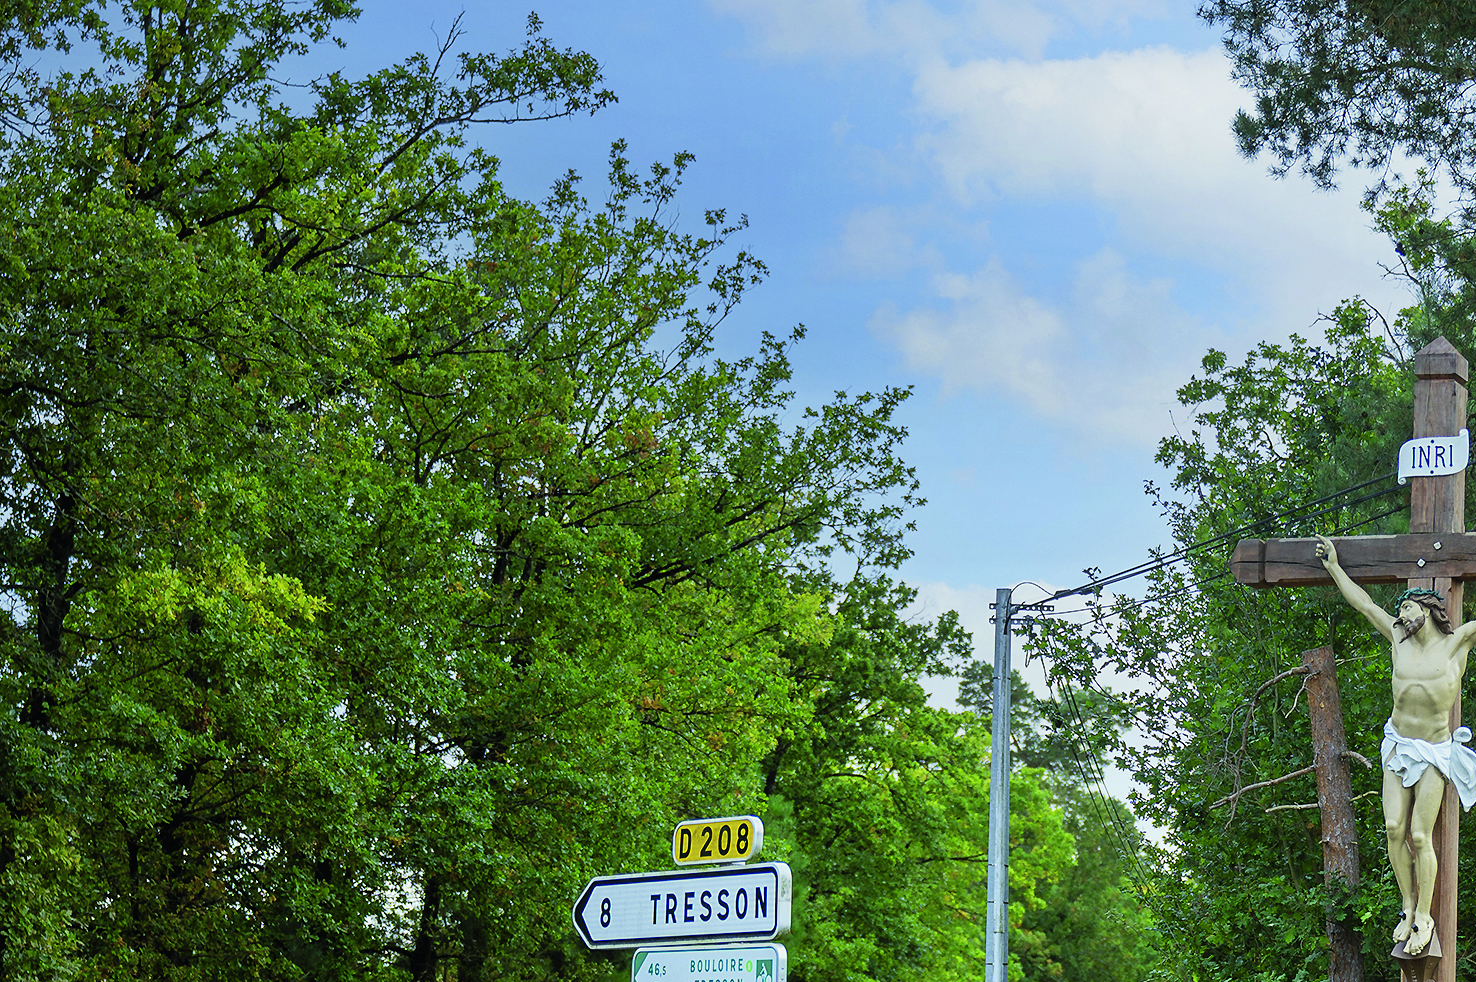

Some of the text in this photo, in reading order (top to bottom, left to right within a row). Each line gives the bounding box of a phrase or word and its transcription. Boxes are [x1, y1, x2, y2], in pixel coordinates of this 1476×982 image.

[1412, 444, 1453, 469] INRI
[679, 823, 749, 859] D 208
[600, 886, 767, 928] 8 TRESSON
[690, 958, 743, 973] BOULOIRE
